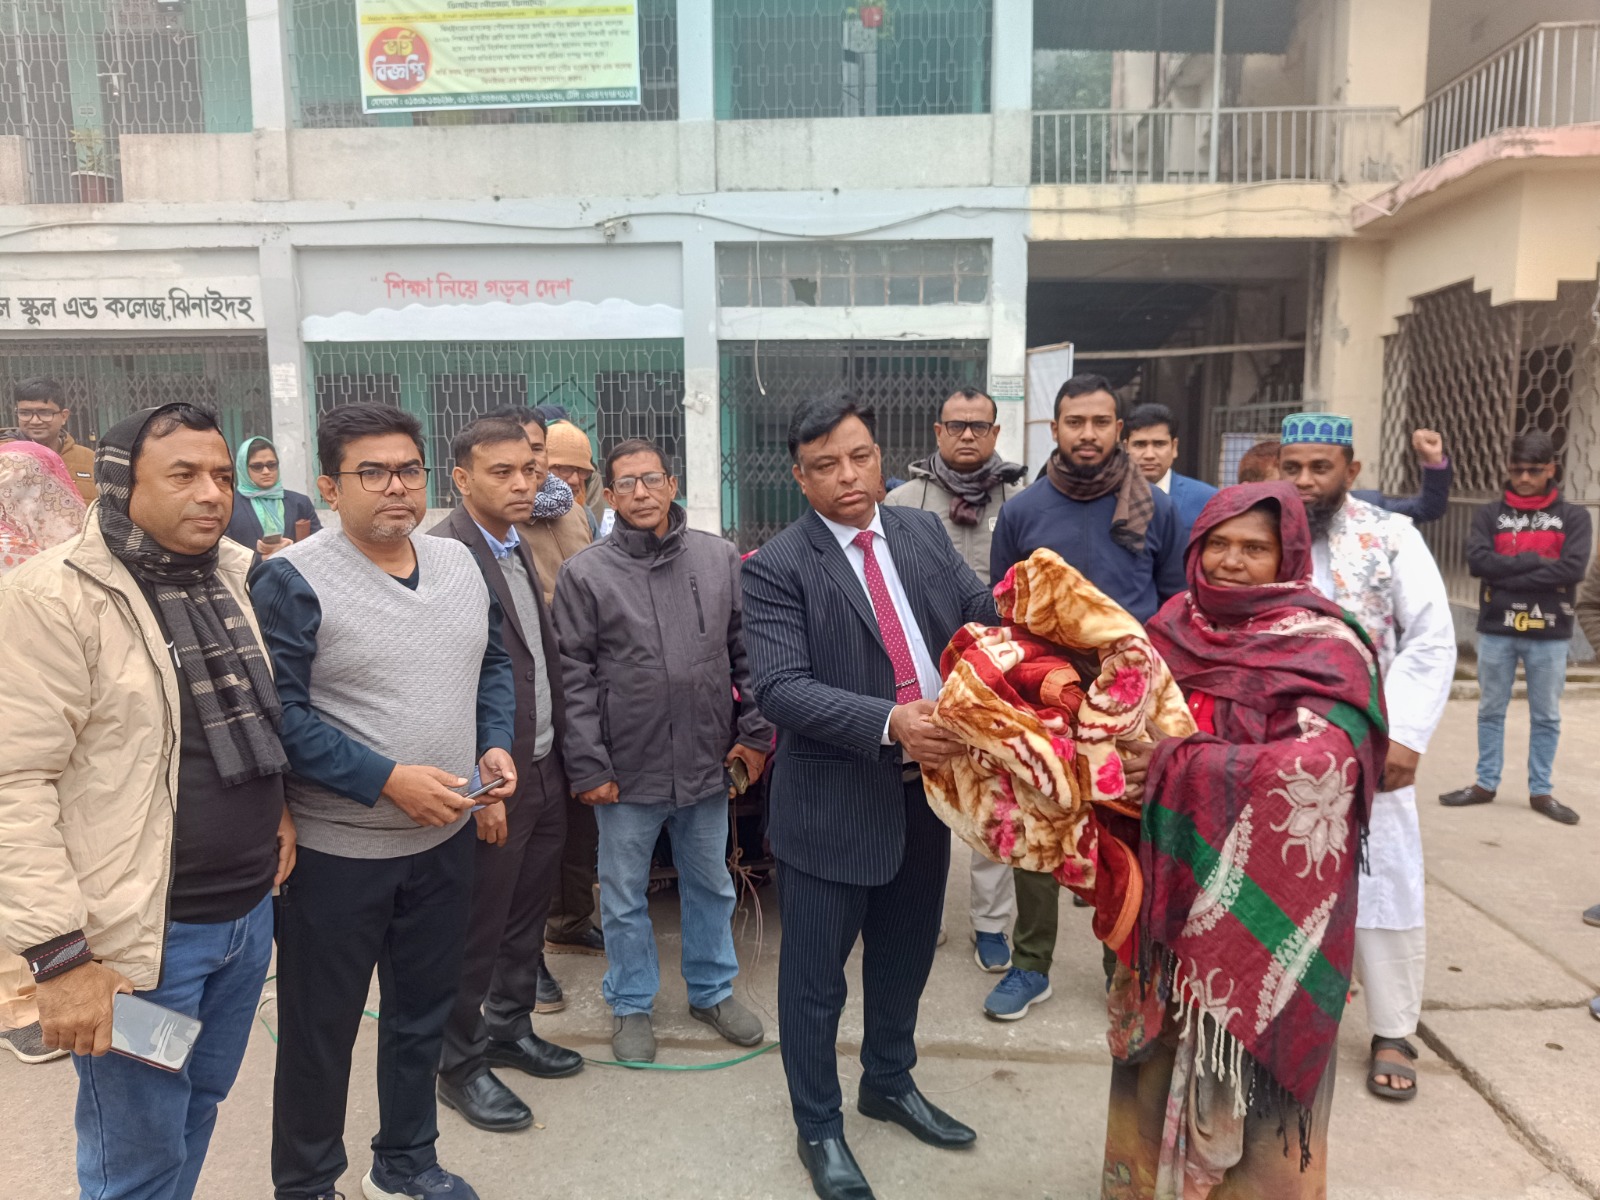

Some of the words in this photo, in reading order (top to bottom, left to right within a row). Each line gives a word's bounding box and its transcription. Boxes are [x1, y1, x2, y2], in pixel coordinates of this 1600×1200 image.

[382, 29, 417, 56] ভর্তি
[373, 54, 426, 81] বিজ্ঞপ্তি
[384, 272, 433, 298] শিক্ষা
[435, 272, 479, 299] নিয়ে
[484, 279, 530, 303] গড়ব
[535, 278, 573, 298] দেশ
[17, 297, 57, 325] স্কুল
[63, 297, 98, 319] এন্ড
